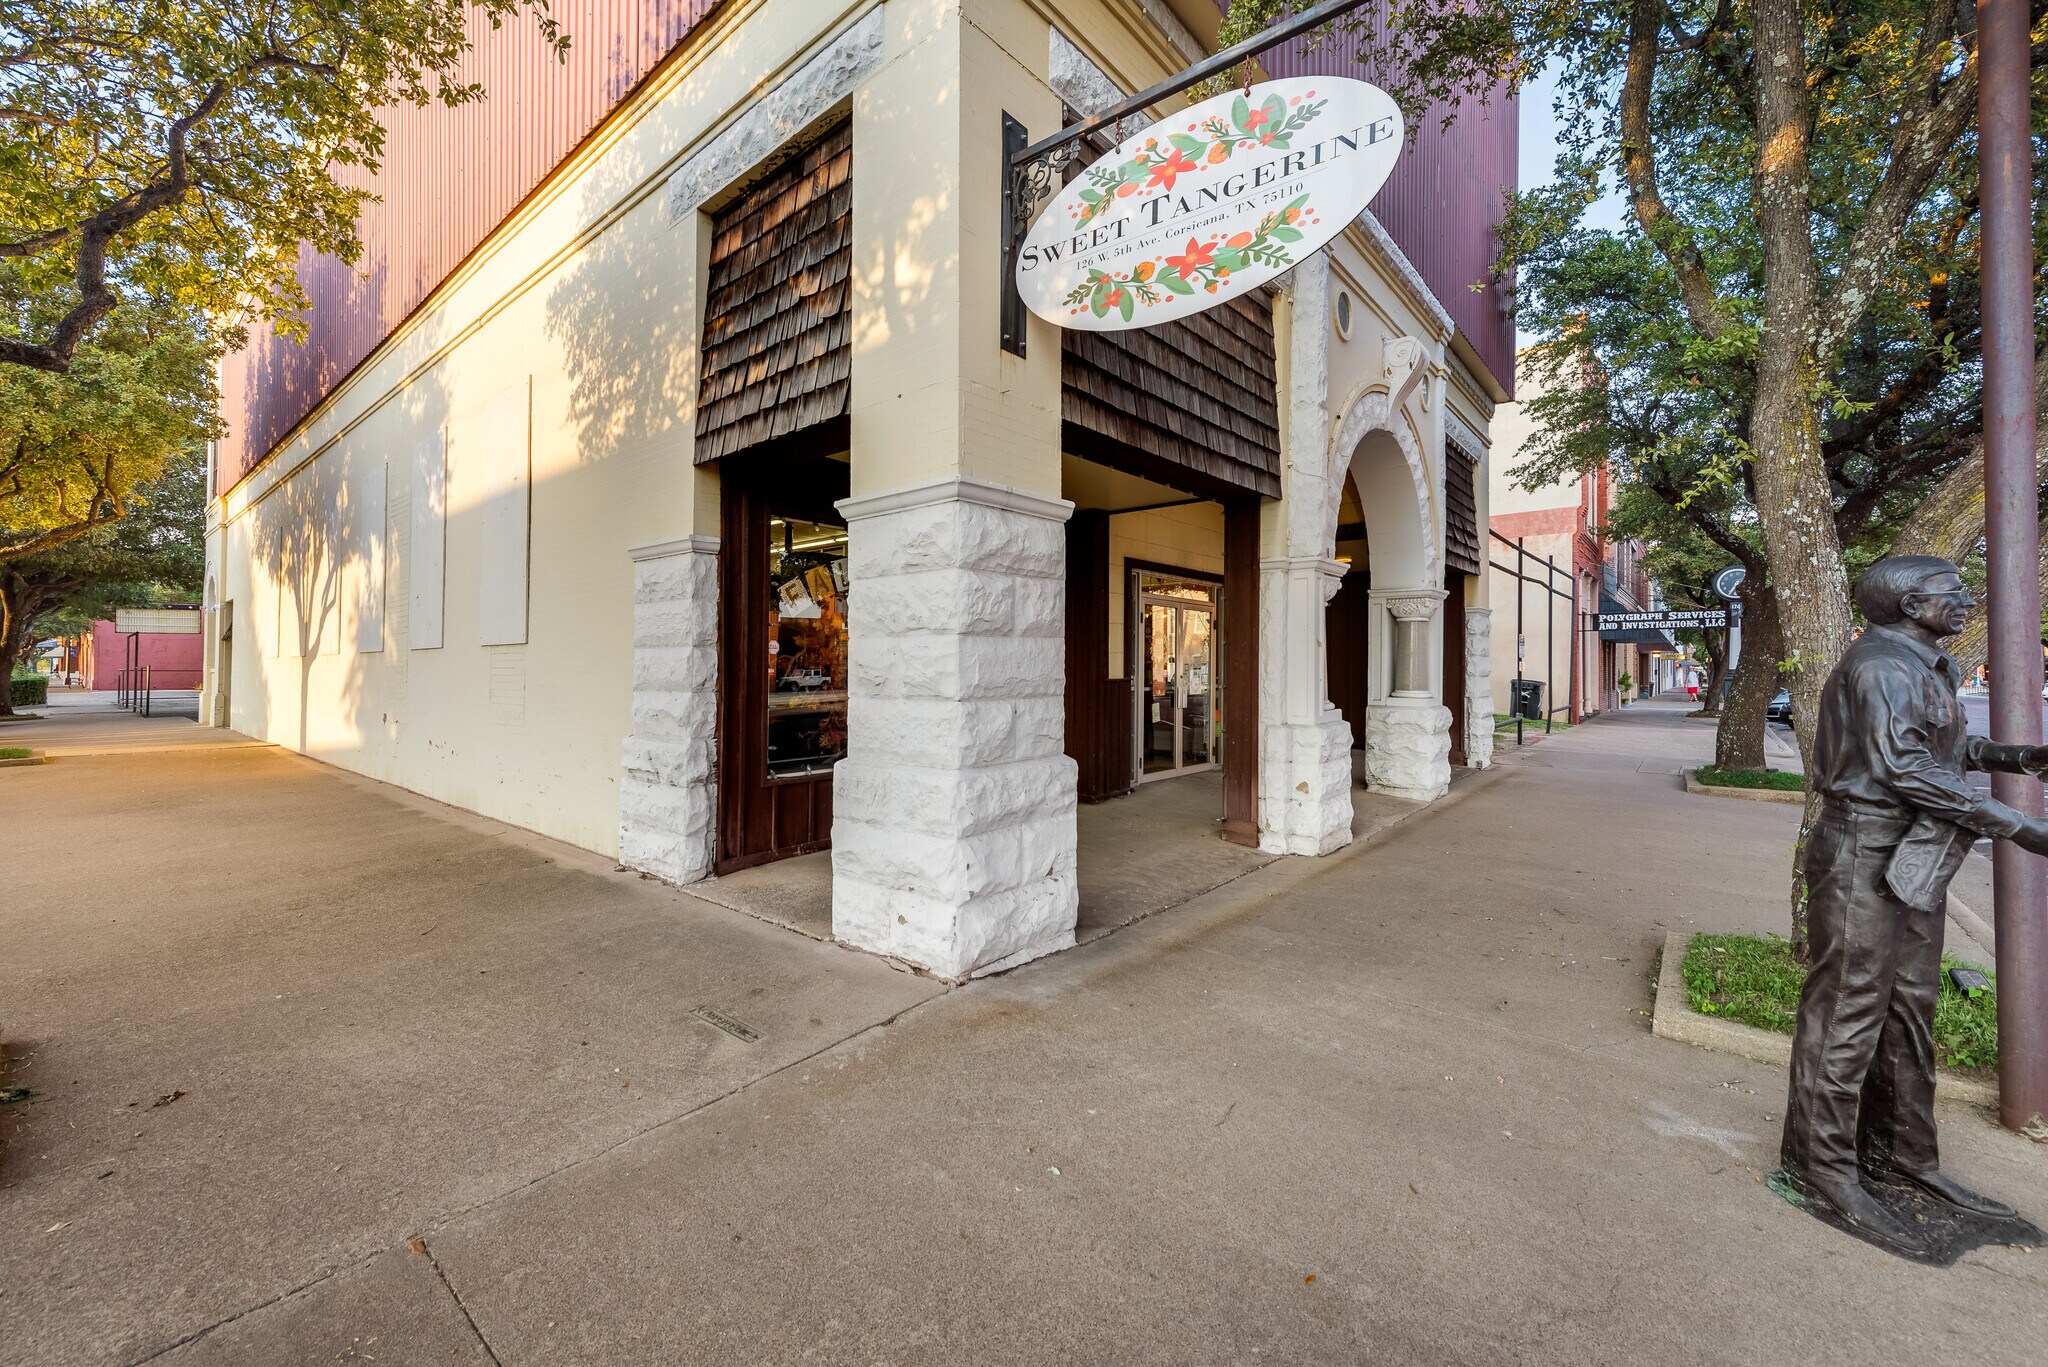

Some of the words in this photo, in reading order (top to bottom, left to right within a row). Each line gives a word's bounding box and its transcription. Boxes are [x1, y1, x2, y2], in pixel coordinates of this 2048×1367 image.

[1021, 216, 1130, 272] SWEET
[1140, 115, 1394, 228] TANGERINE
[1076, 256, 1094, 271] 126
[1097, 250, 1110, 262] W.
[1113, 244, 1132, 258] 5th
[1136, 237, 1161, 251] Ave.
[1234, 198, 1257, 215] TX
[1262, 182, 1304, 205] 75110
[1598, 612, 1663, 623] POLYGRAPH
[1668, 610, 1726, 620] SERVICES
[1598, 622, 1618, 631] AND
[1705, 618, 1726, 627] LLC
